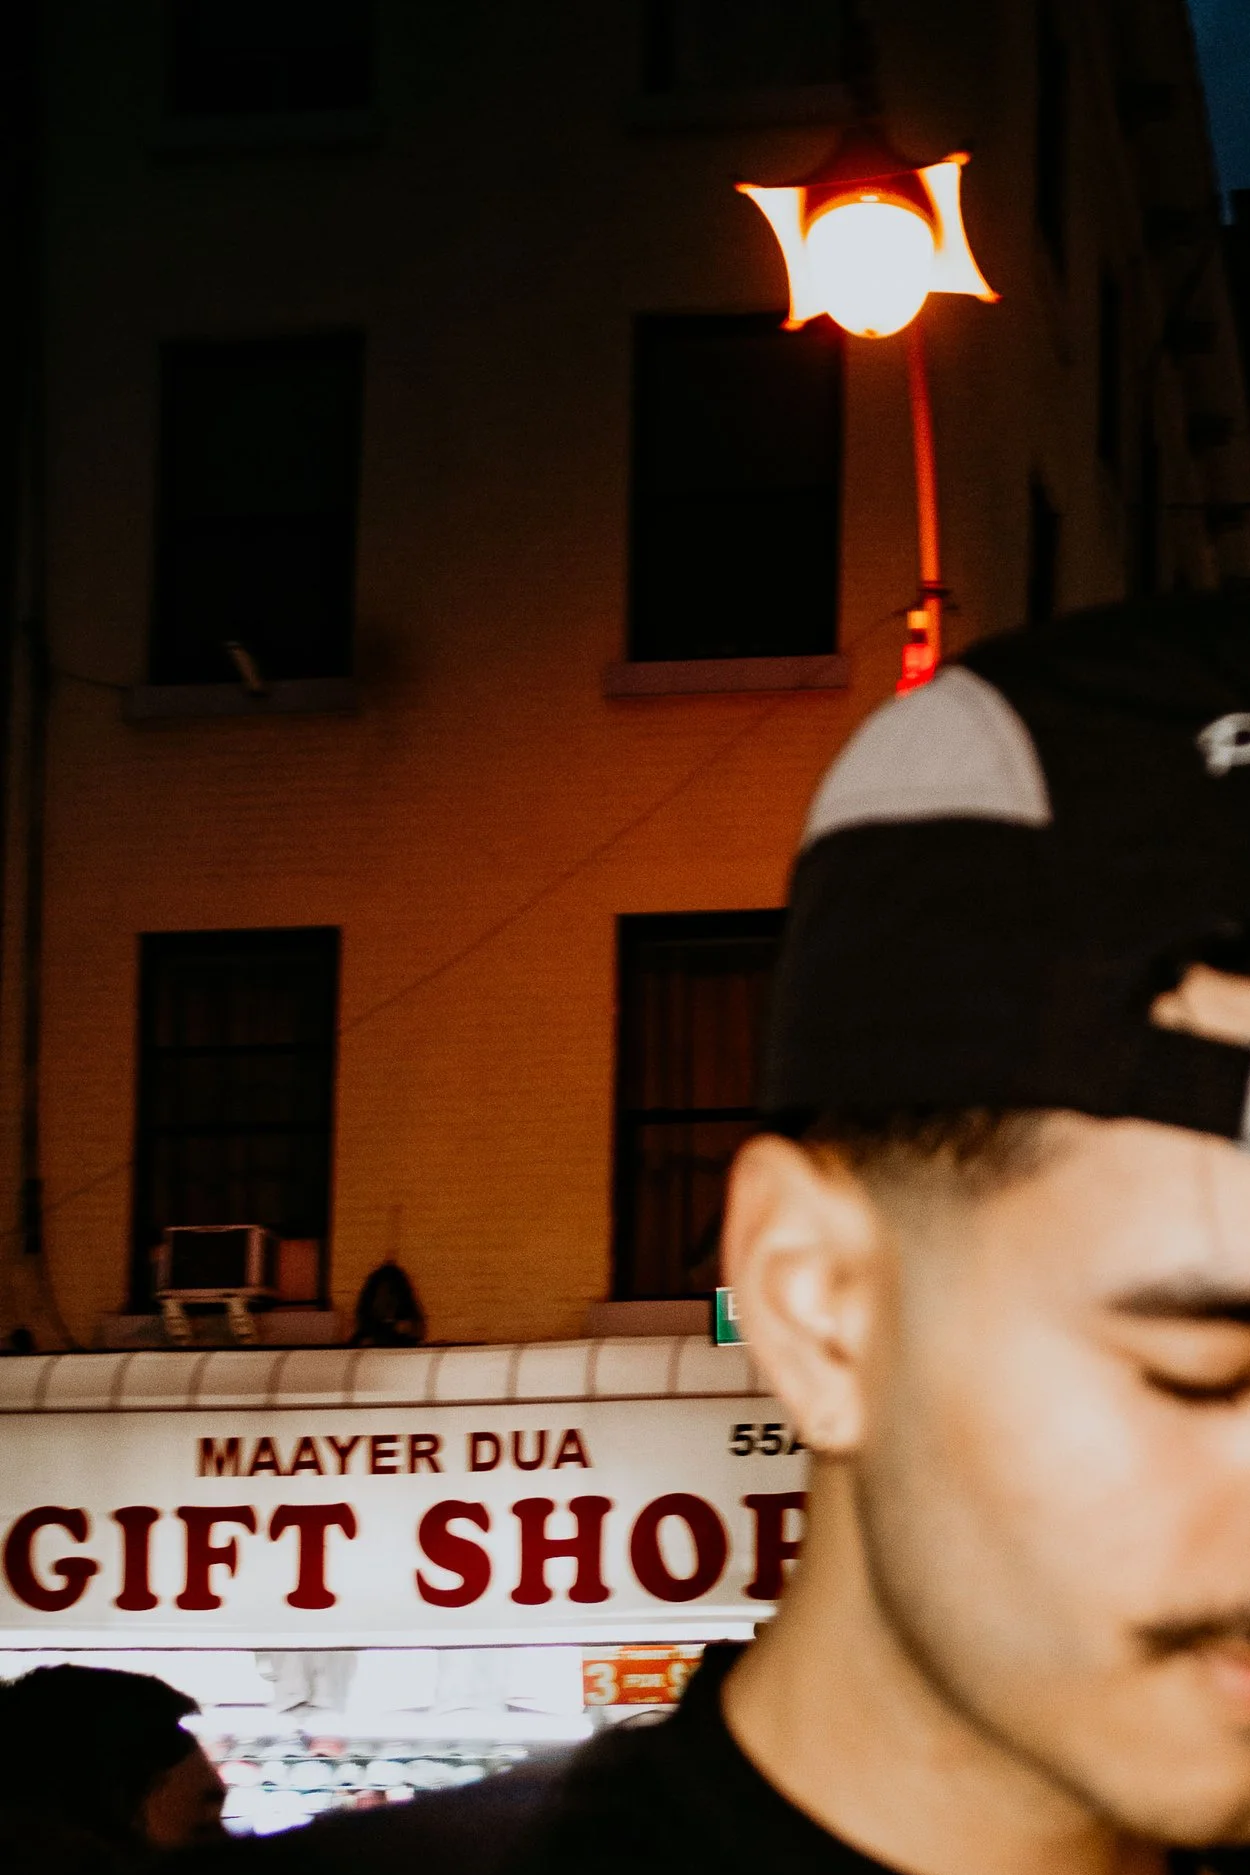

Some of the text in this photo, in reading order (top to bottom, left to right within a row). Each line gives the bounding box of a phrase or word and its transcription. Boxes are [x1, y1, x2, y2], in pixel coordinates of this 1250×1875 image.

[198, 1428, 592, 1477] MAAYER DUA
[2, 1502, 358, 1612] GIFT
